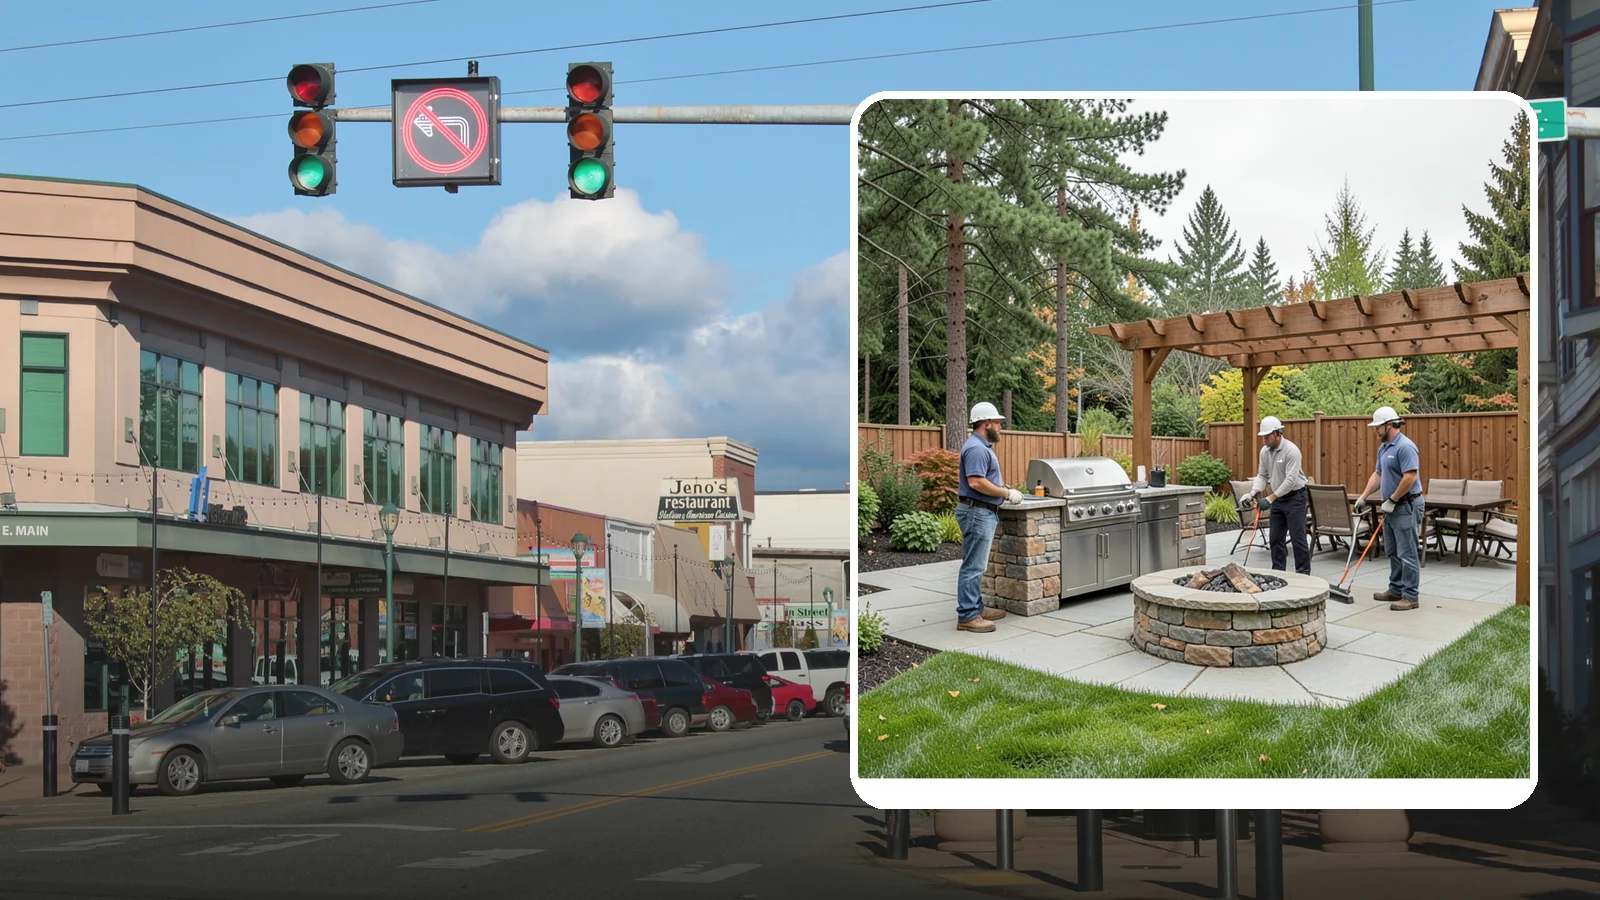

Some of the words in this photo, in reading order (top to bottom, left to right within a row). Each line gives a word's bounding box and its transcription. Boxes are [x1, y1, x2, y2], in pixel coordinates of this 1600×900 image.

[670, 480, 727, 494] Jeno's
[665, 496, 731, 509] restaurant
[658, 510, 681, 520] Italian
[686, 509, 714, 519] American
[715, 509, 737, 519] Cuisine
[2, 525, 13, 536] E.
[15, 525, 49, 536] MAIN
[797, 607, 828, 617] Street
